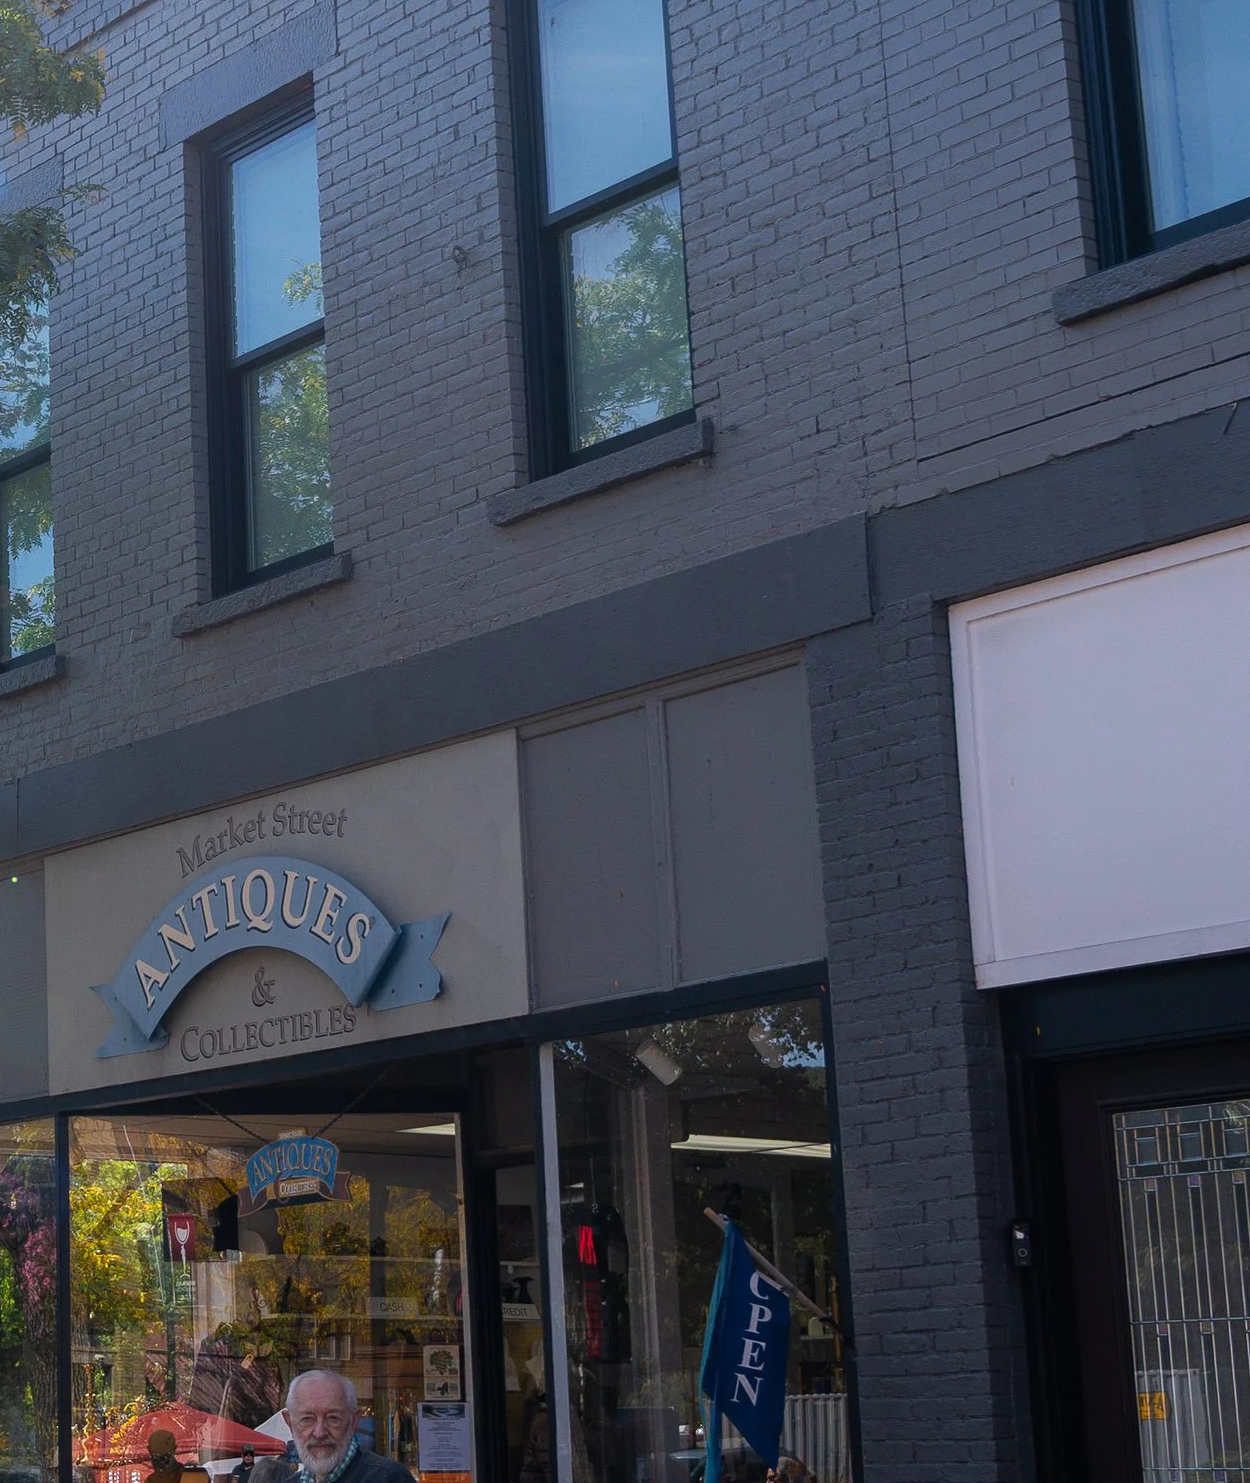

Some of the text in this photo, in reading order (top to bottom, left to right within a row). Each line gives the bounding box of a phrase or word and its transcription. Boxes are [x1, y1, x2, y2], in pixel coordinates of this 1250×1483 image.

[175, 802, 348, 878] Market Street
[135, 869, 374, 1007] ANTIQUES
[251, 966, 277, 1008] &
[180, 1003, 357, 1062] COLLECTIBLES
[253, 1142, 334, 1187] ANTIQUES
[379, 1302, 404, 1312] CASH
[502, 1307, 528, 1317] REDIT
